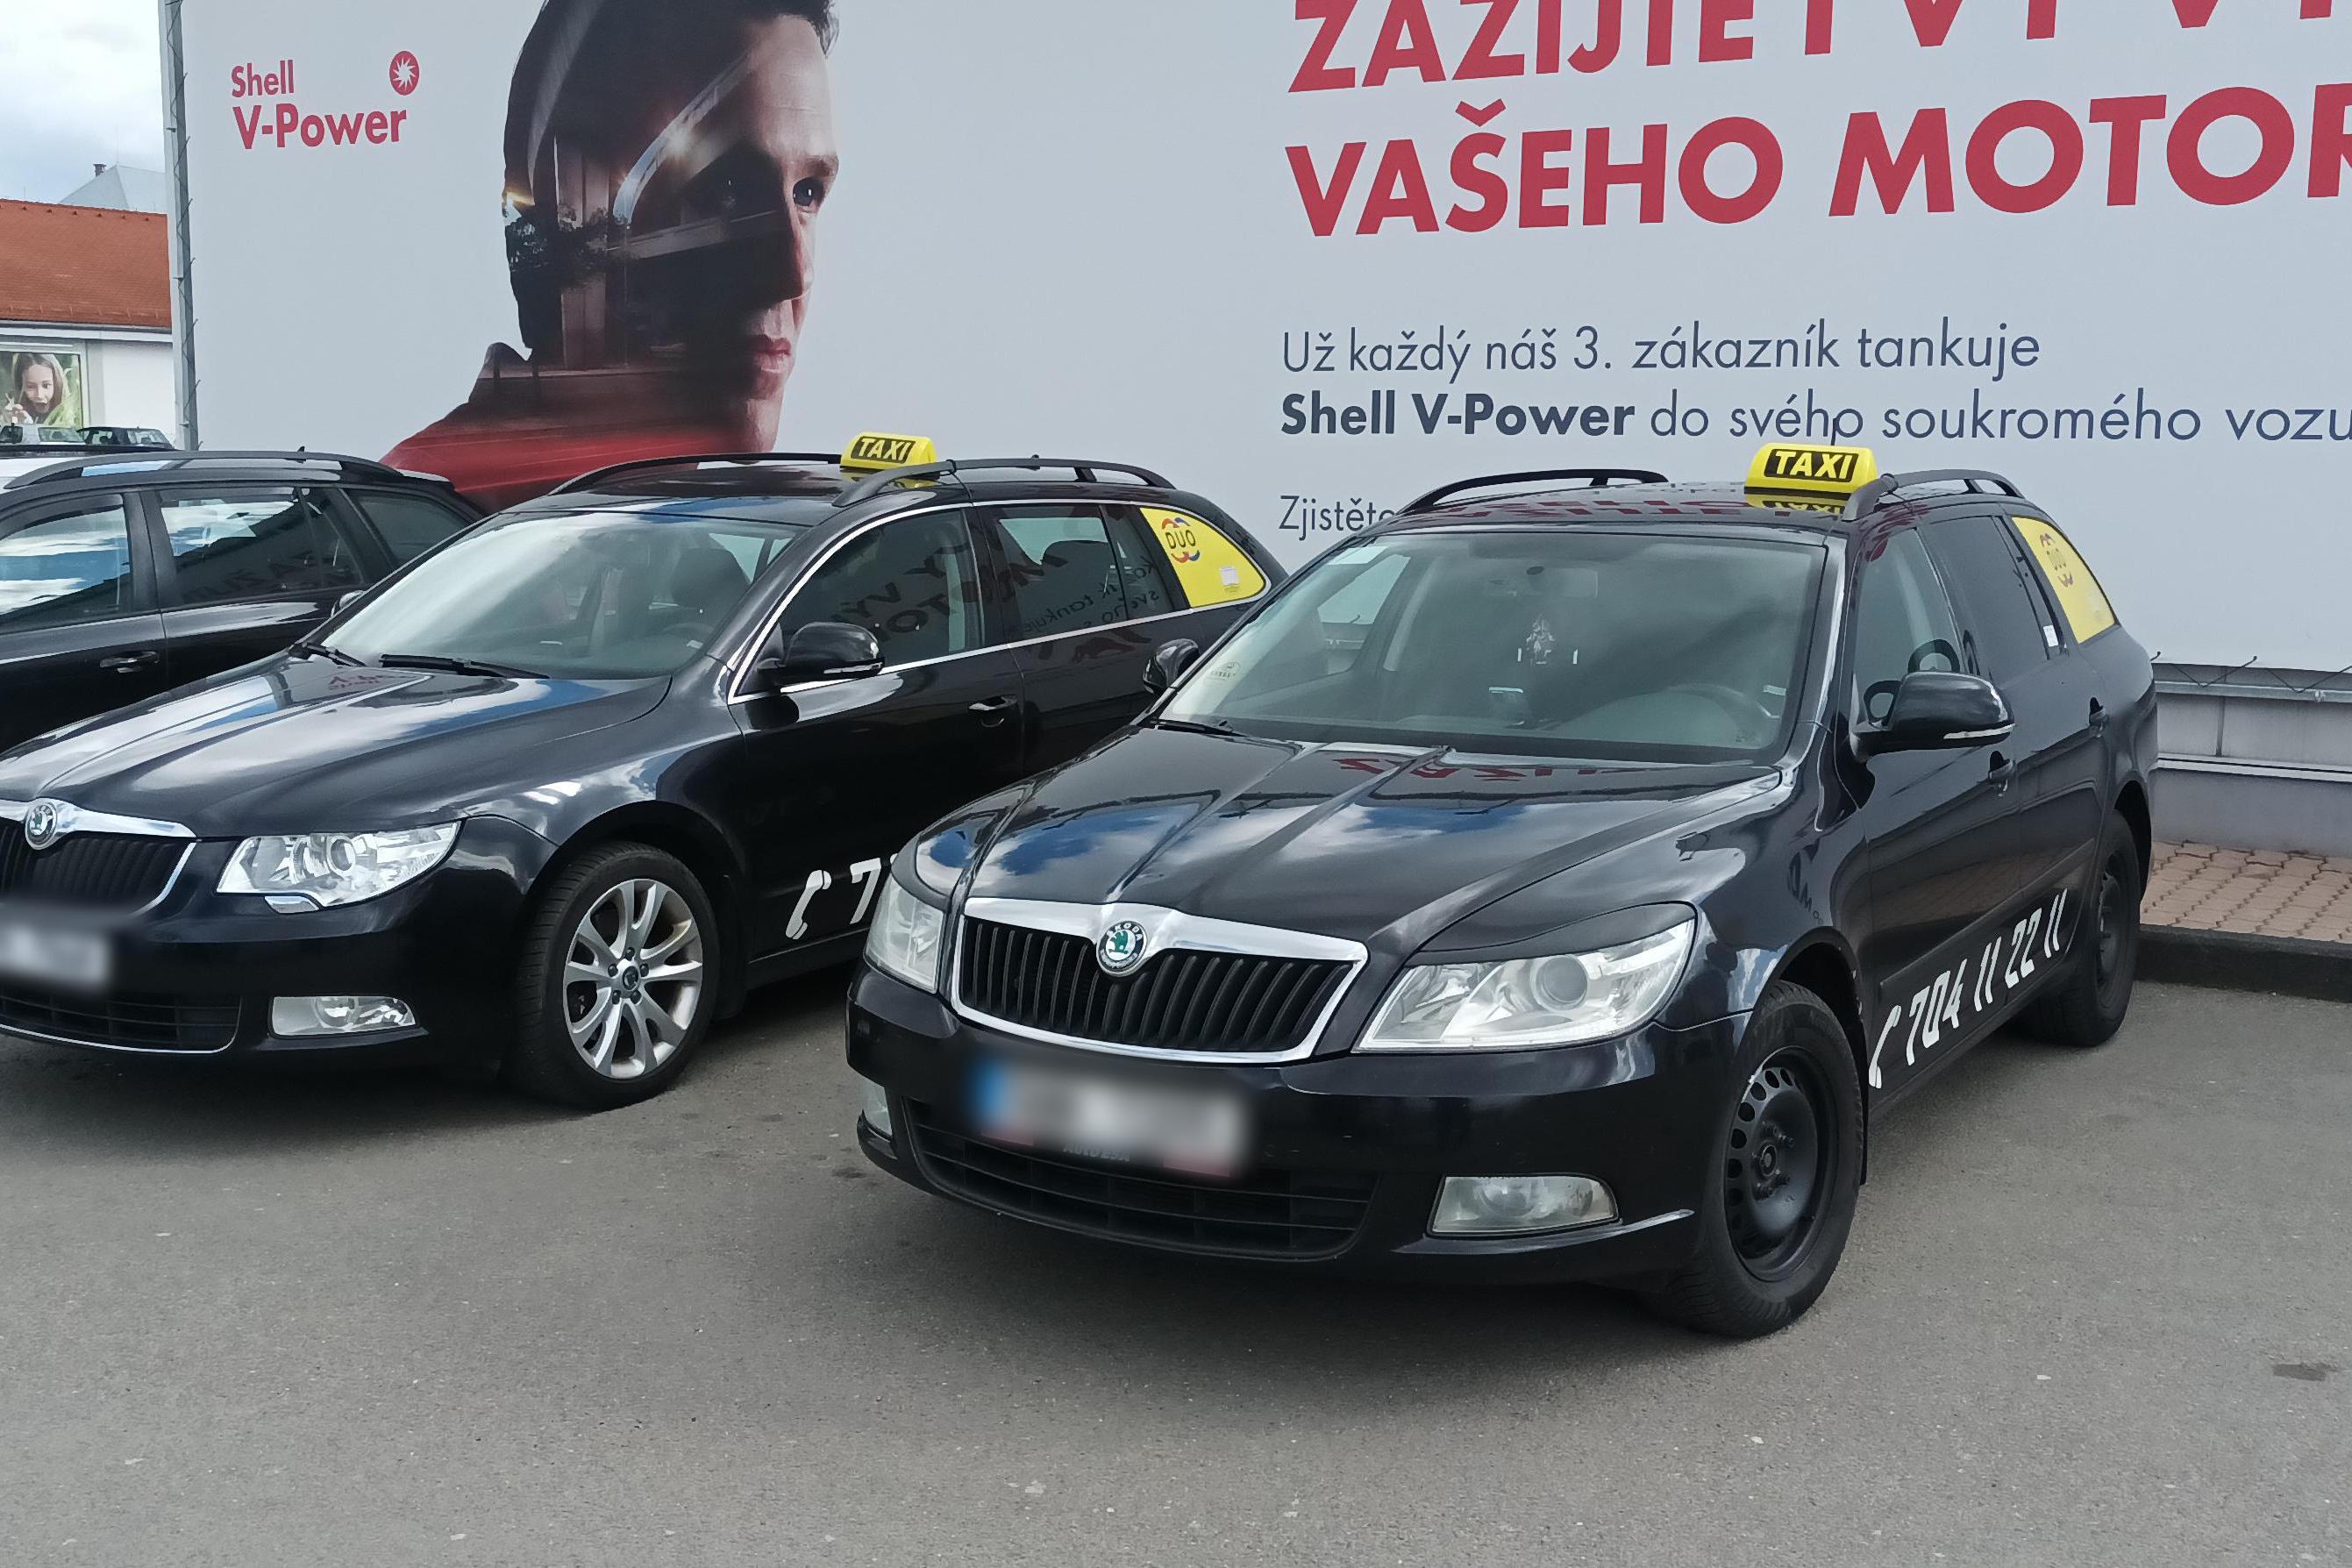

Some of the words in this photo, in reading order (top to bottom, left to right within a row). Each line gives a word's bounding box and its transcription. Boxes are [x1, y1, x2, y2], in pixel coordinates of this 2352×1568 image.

[232, 60, 295, 97] Shell
[233, 103, 408, 149] V-Power
[1285, 98, 1783, 237] VAŠEHO
[1282, 331, 1336, 372] Už
[1350, 325, 1472, 384] každý
[1486, 328, 1557, 370] náš
[1573, 326, 1612, 370] 3.
[1632, 318, 1840, 369] zákazník
[1857, 316, 2040, 382] tankuje
[1280, 389, 1395, 436] Shell
[1411, 393, 1636, 437] V-Power
[1650, 388, 1709, 437] do
[1729, 388, 1864, 438] svého
[1881, 387, 2201, 440] soukromého
[858, 437, 912, 461] TAXI
[1775, 451, 1852, 480] TAXI
[1165, 529, 1196, 550] DUO
[849, 857, 898, 925] 7
[1906, 958, 1968, 1066] 704
[2005, 907, 2042, 989] 22
